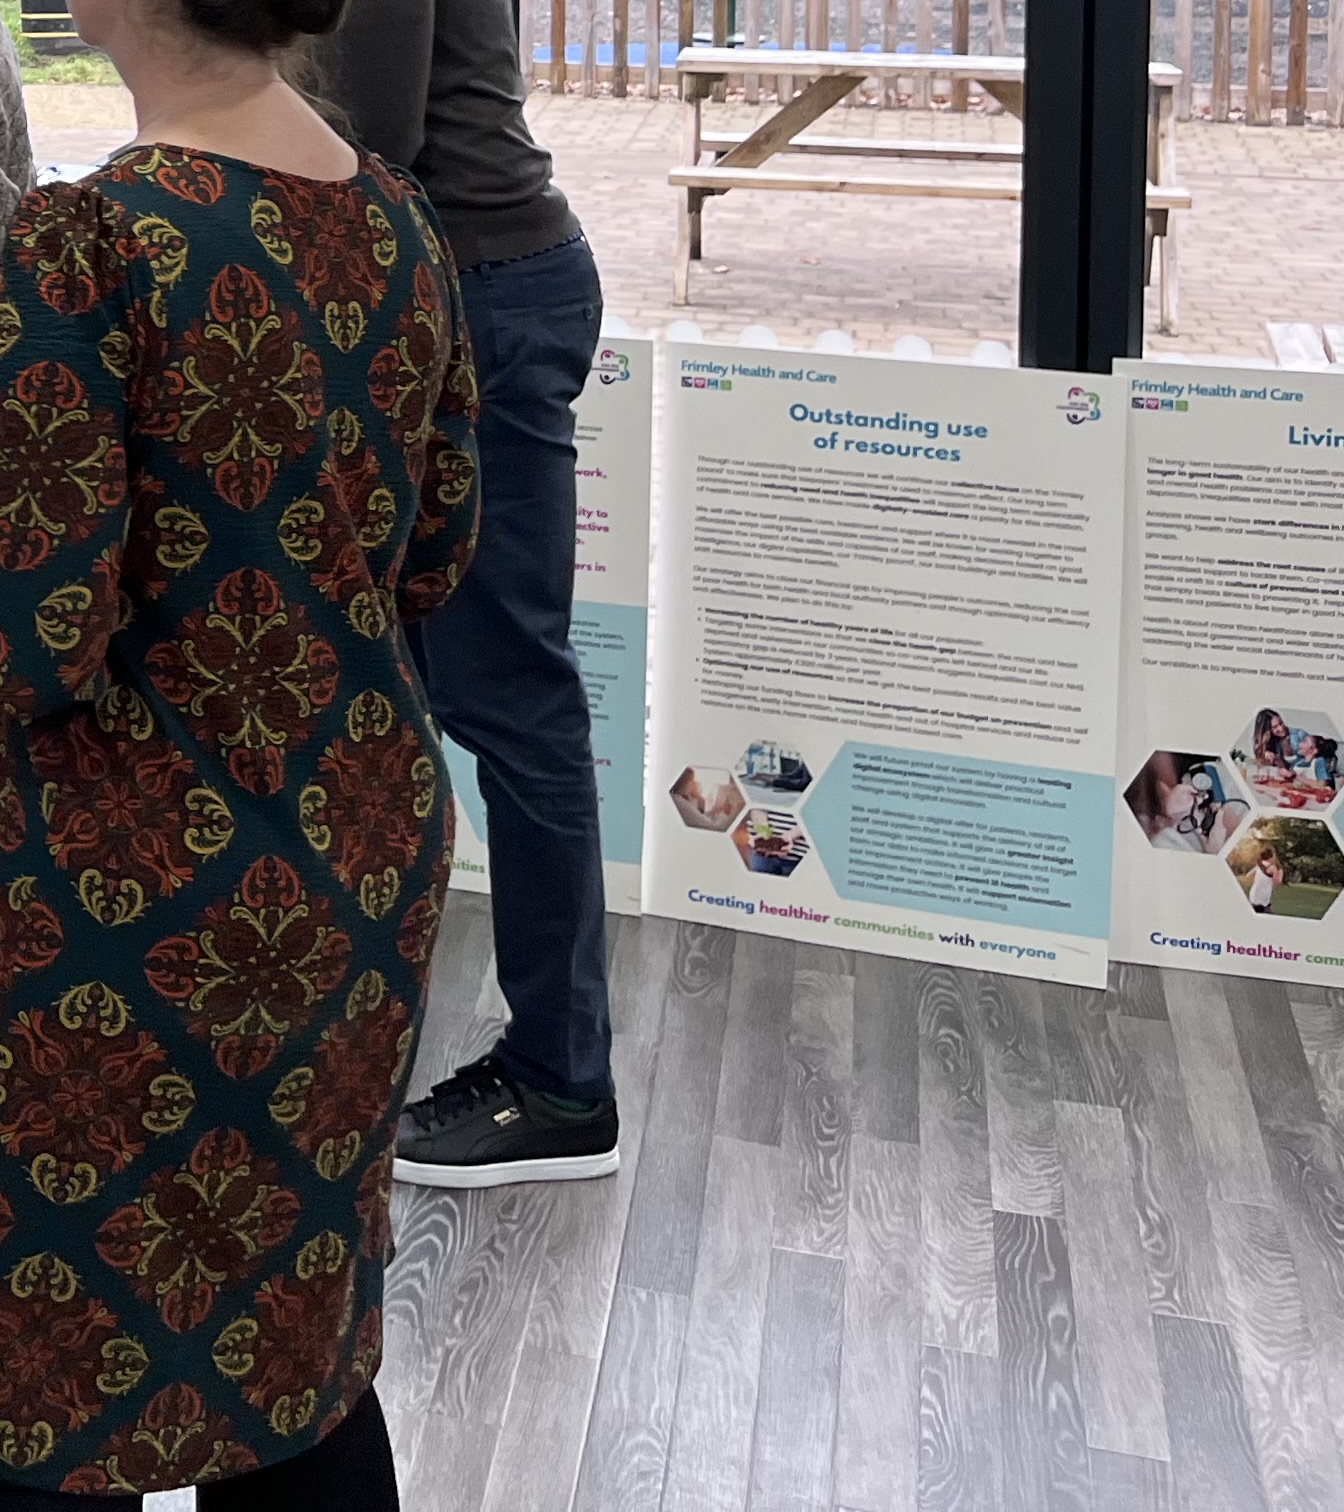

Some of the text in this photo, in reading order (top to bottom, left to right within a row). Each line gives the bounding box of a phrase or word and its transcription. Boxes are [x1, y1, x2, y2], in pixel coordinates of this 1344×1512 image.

[681, 359, 837, 384] Frimley Health and Care
[1131, 379, 1304, 402] Frimley Health and Care
[789, 403, 988, 440] Outstanding use
[813, 432, 961, 462] of resources
[687, 889, 1056, 960] Creating healthier communities with everyone
[1150, 932, 1302, 961] Creating healthier
